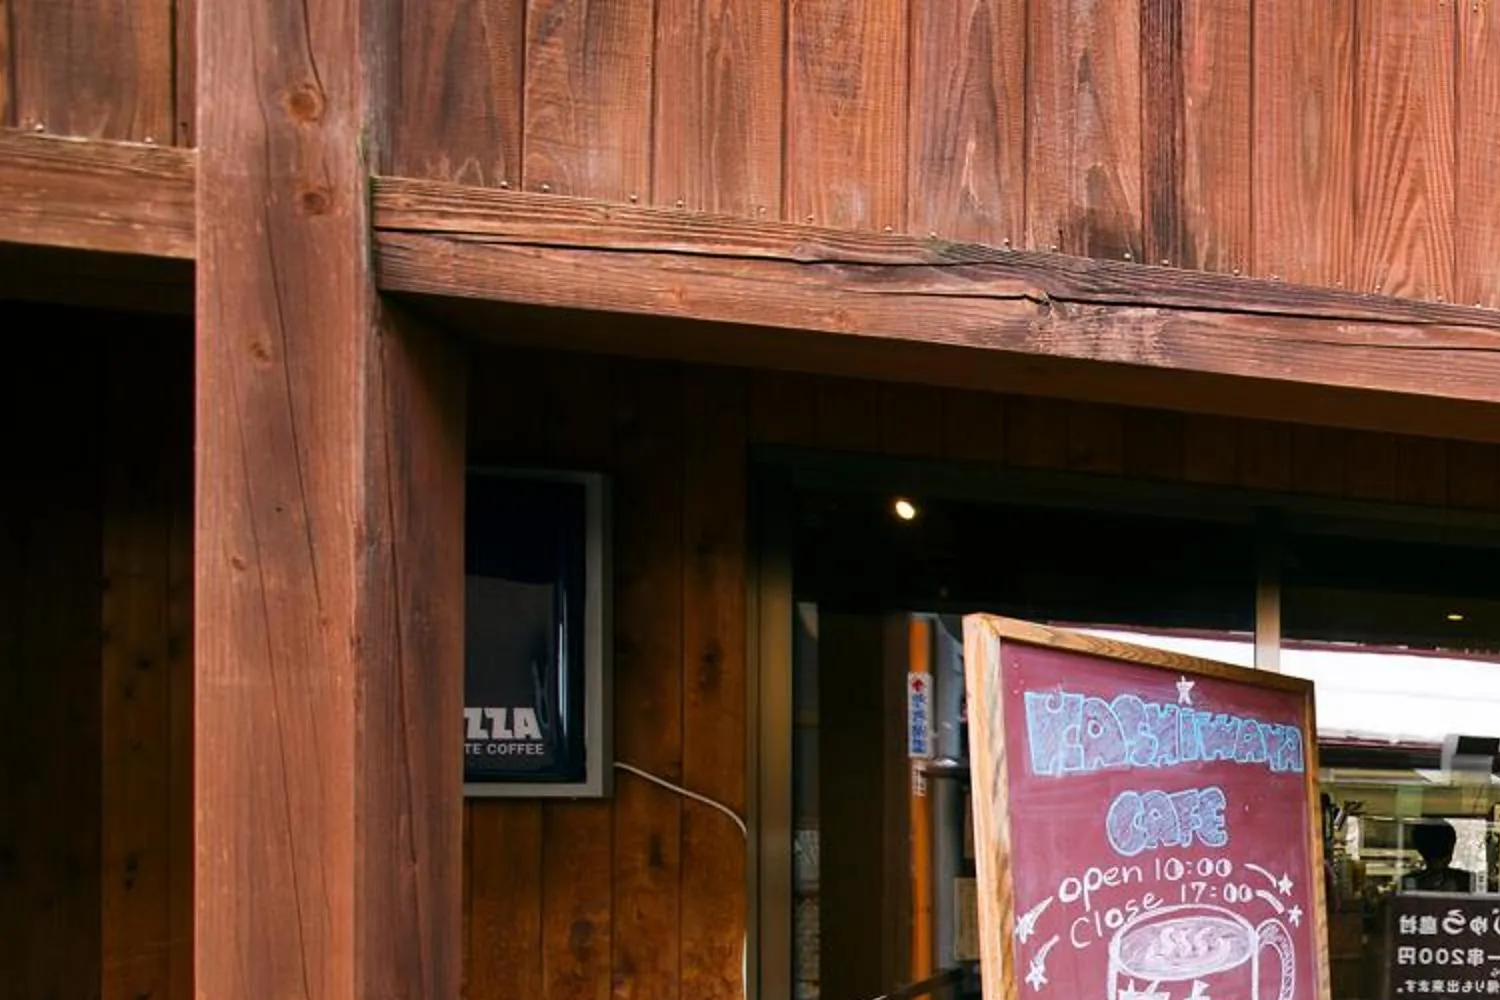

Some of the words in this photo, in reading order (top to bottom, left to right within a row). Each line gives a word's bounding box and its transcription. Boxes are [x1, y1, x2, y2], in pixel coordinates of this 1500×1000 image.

[464, 707, 542, 739] ZZA
[464, 743, 482, 755] TE
[486, 743, 545, 755] COFFEE
[1107, 786, 1229, 856] CAFE
[1058, 866, 1143, 912] open
[1155, 857, 1233, 881] 10:00
[1180, 881, 1254, 903] 17:00
